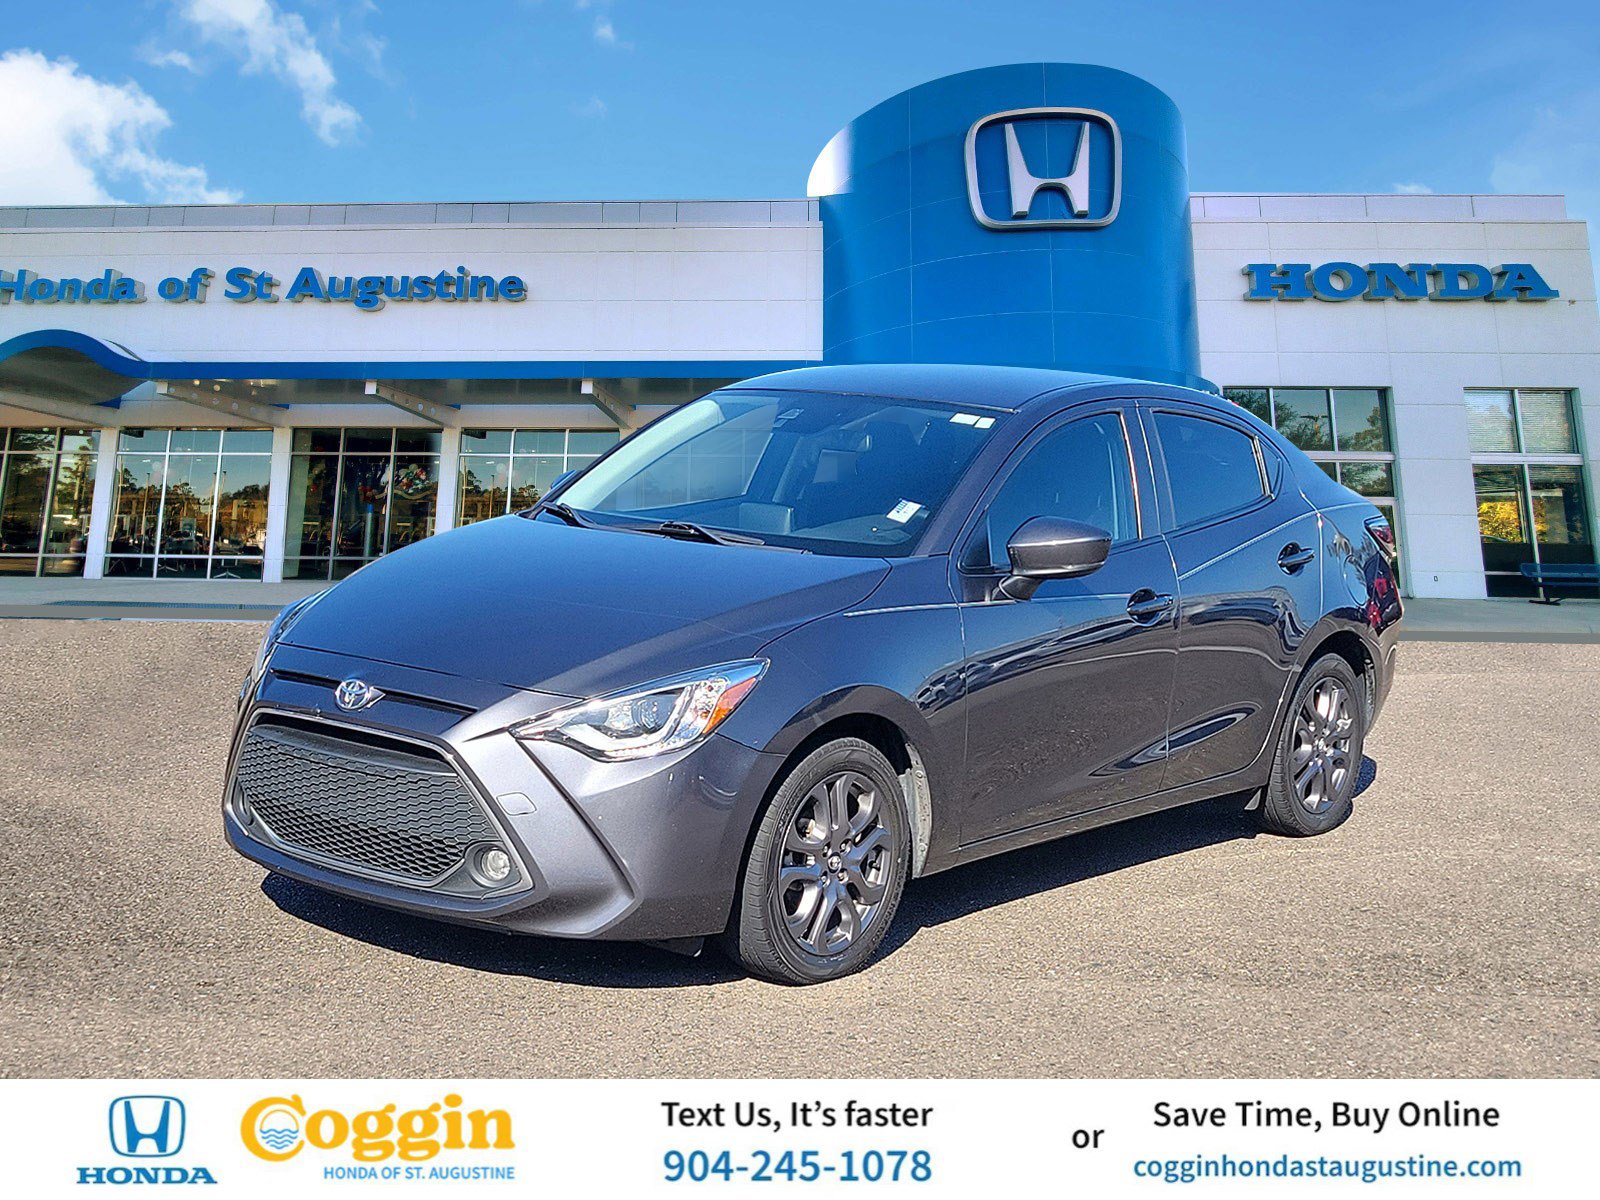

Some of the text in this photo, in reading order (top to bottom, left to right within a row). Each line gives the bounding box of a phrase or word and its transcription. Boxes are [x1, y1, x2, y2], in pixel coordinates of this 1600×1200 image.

[0, 265, 528, 311] Honda of St Augustine
[1243, 262, 1560, 302] HONDA
